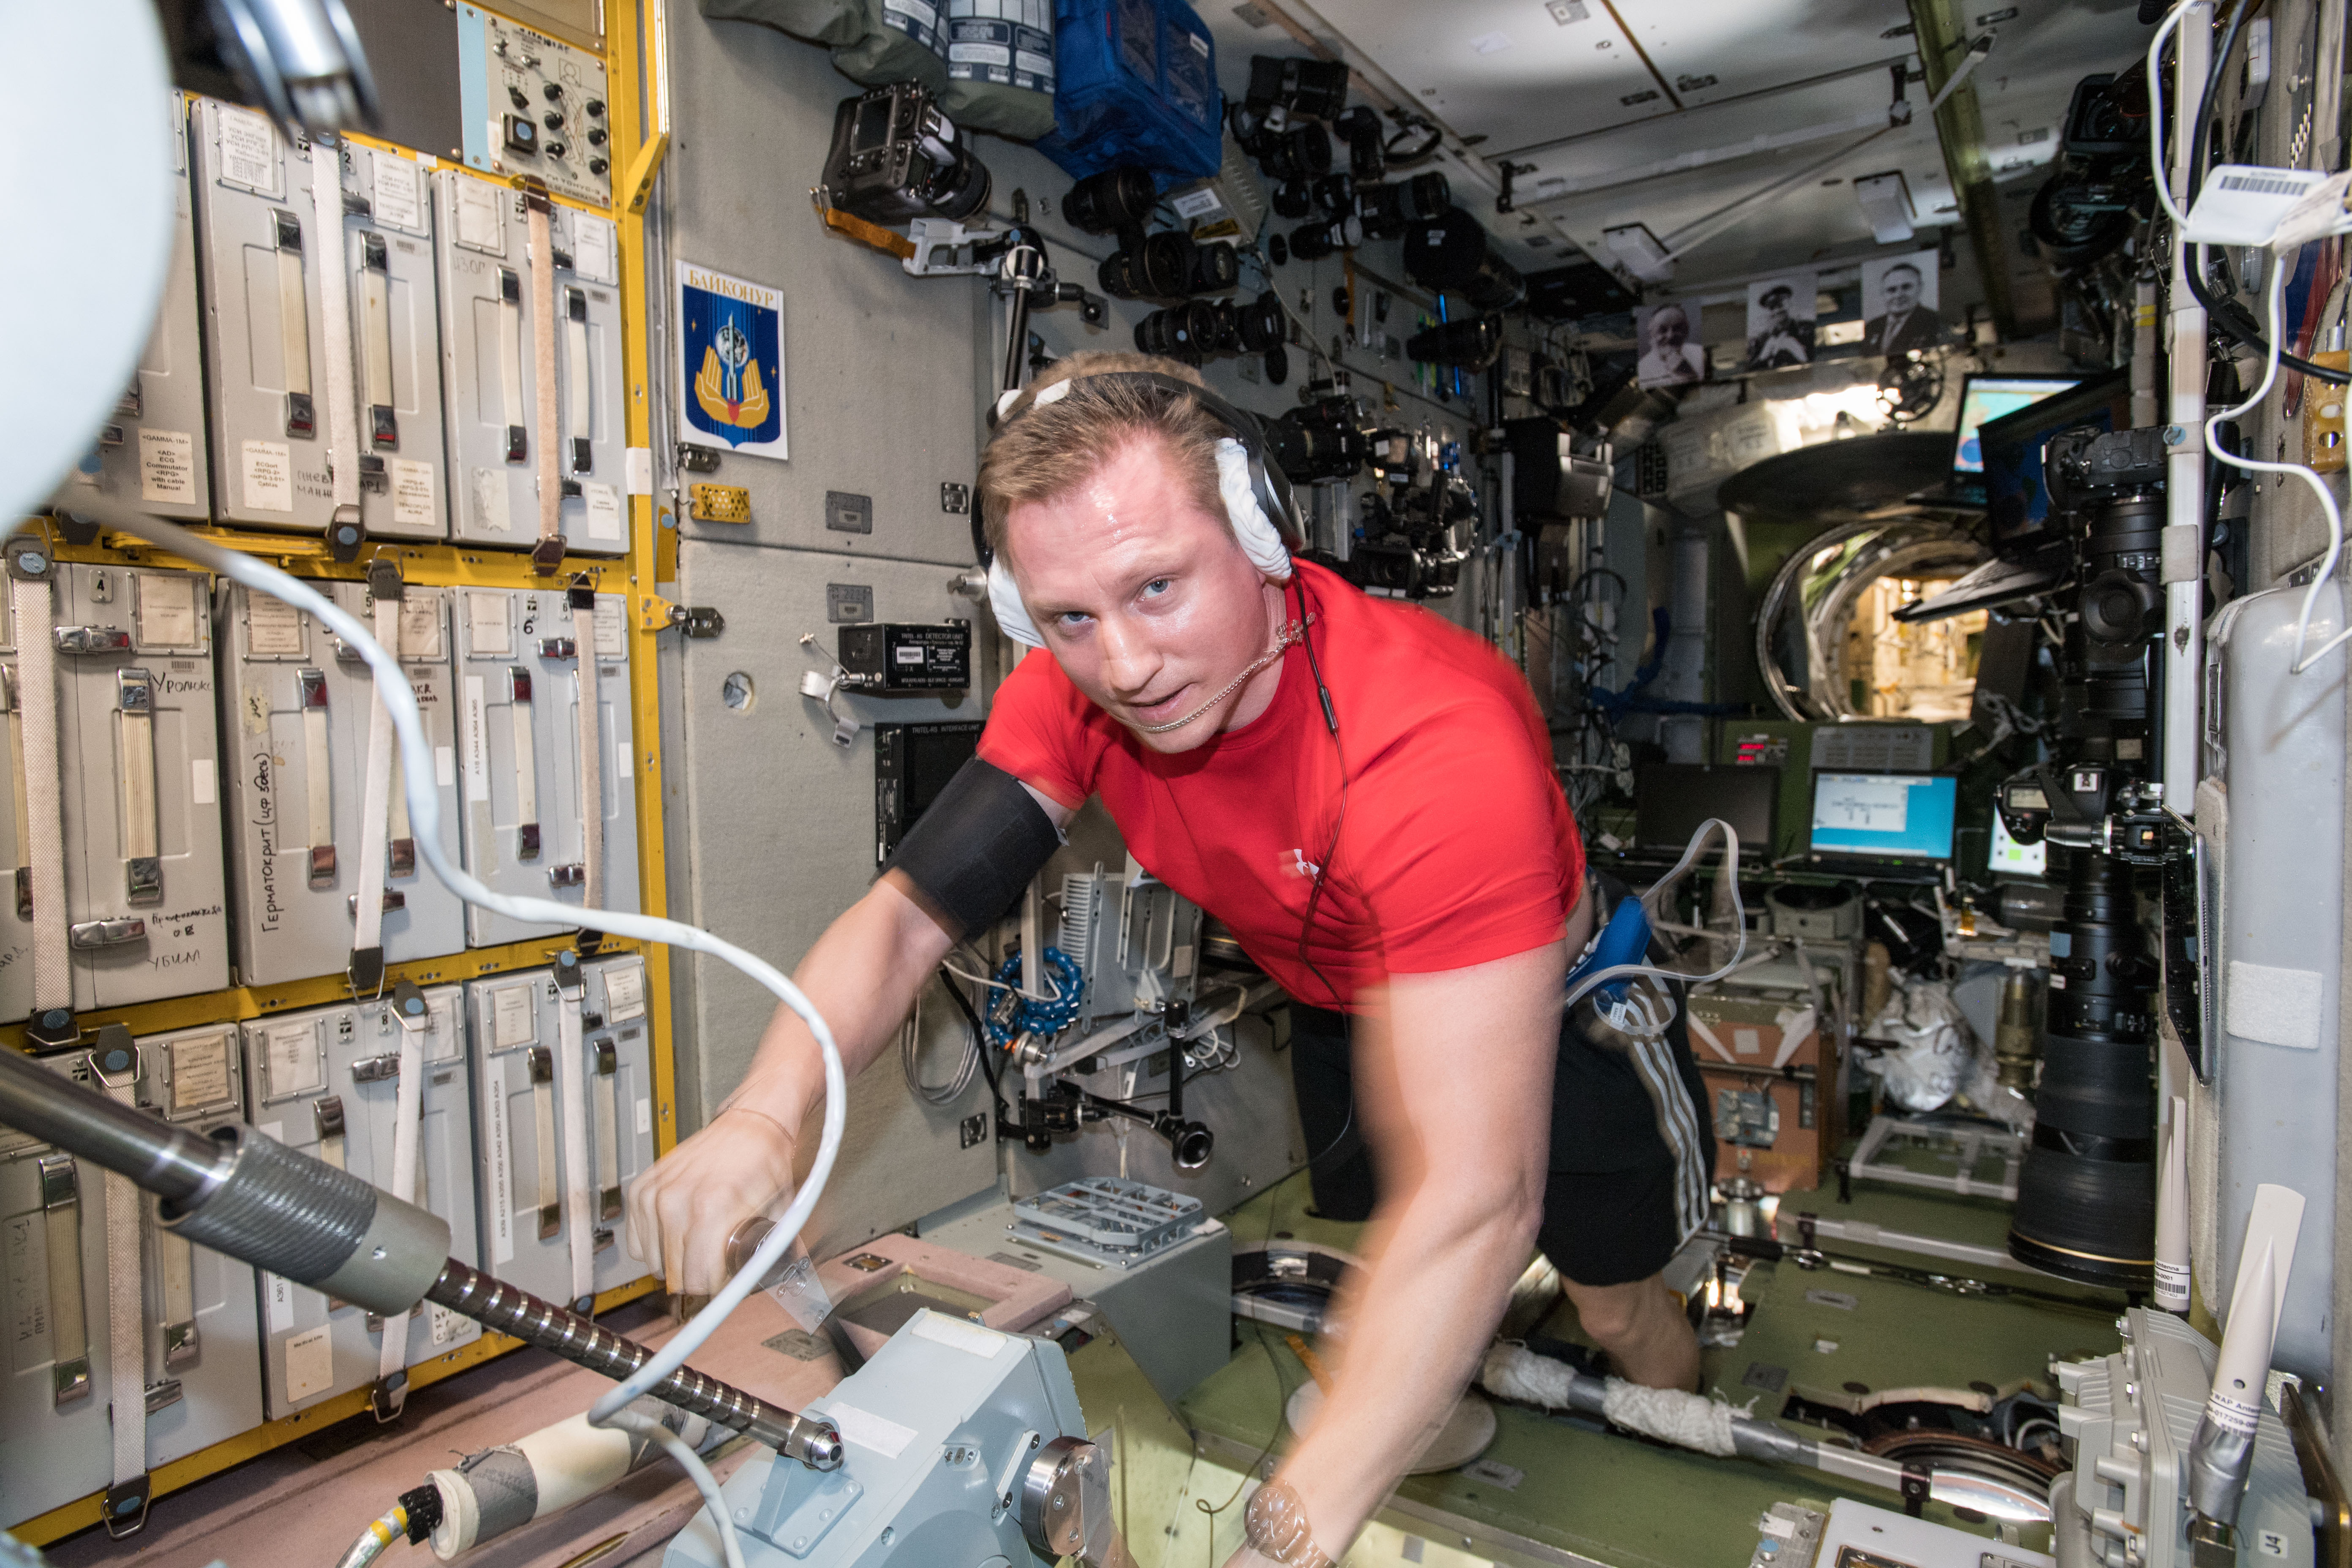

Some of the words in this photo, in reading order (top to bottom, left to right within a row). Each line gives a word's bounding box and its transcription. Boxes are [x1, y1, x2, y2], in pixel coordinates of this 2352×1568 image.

[689, 269, 773, 307] БАЙКОНУР
[147, 462, 188, 471] Commutator
[366, 597, 372, 607] 5
[523, 618, 534, 634] 6
[940, 724, 967, 732] INTERFACE
[381, 1014, 388, 1026] 8
[2215, 1394, 2233, 1405] WAP
[2264, 1537, 2281, 1555] J4
